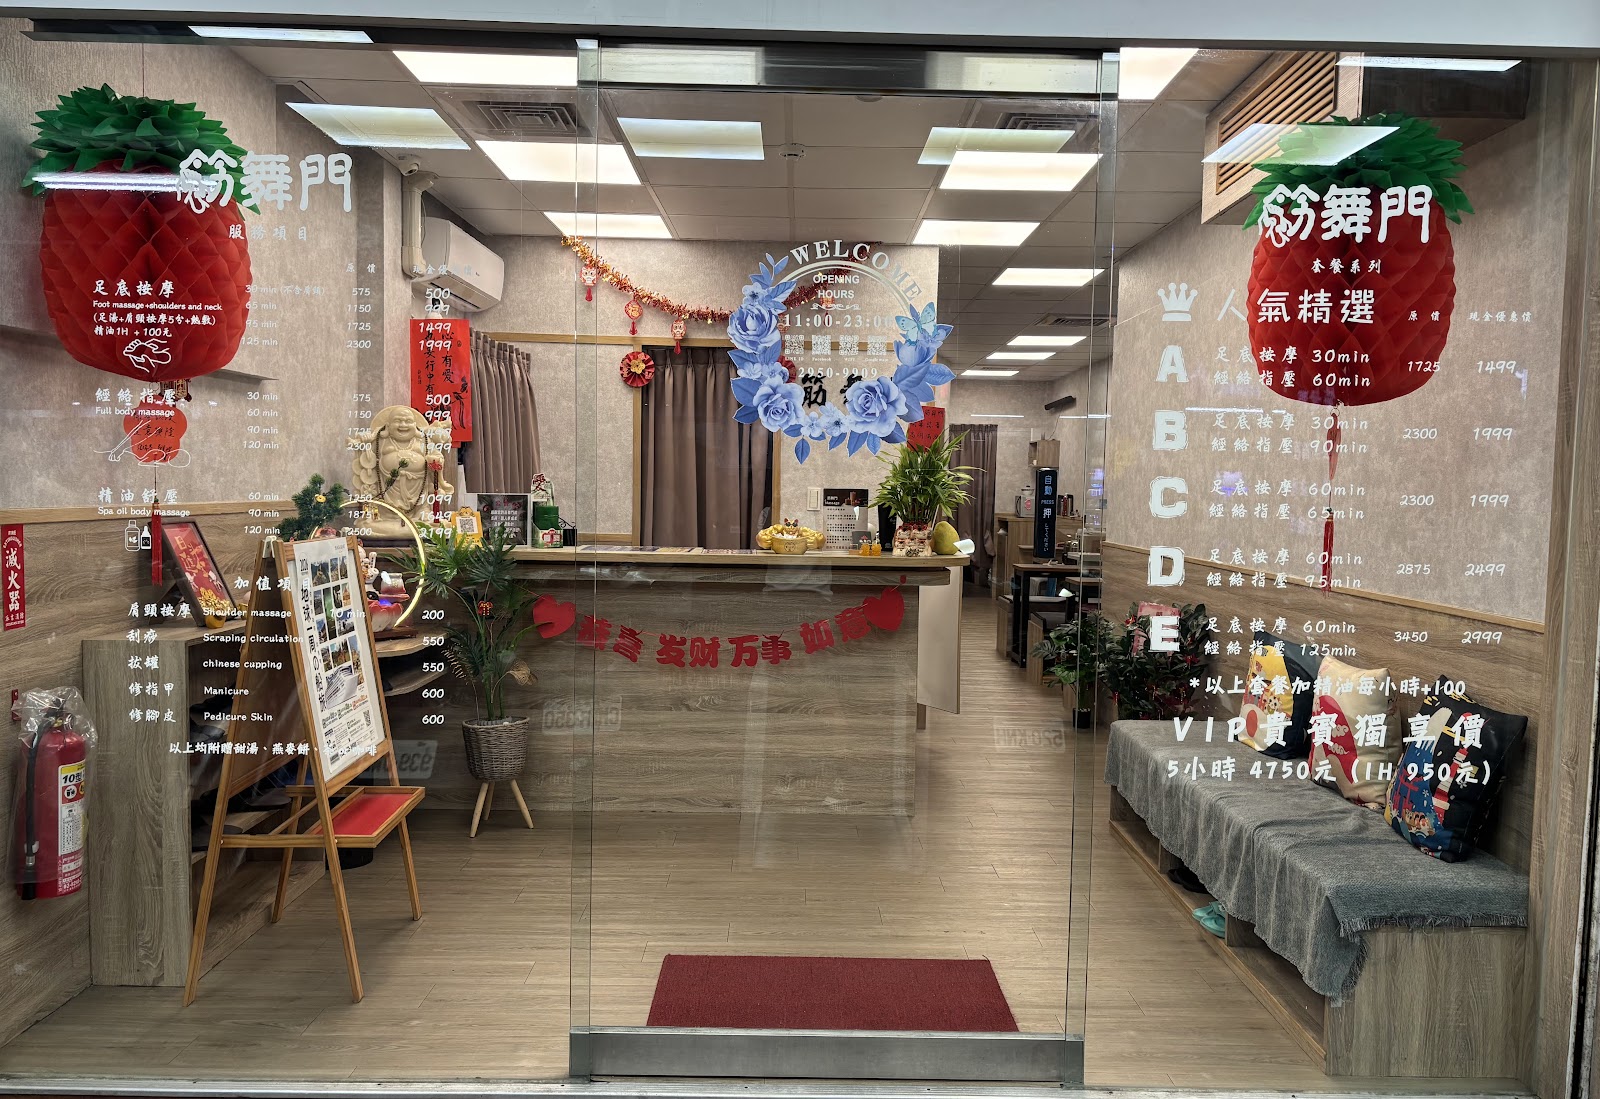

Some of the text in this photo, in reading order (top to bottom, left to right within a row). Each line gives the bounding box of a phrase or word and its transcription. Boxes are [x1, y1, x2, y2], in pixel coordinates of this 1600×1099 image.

[228, 224, 306, 240] 服務項目
[790, 239, 922, 301] WELCOME
[1311, 259, 1382, 274] 套餐系列
[813, 274, 860, 284] OPENING
[93, 280, 174, 298] 足底按摩
[245, 284, 258, 294] 30
[260, 285, 277, 294] min
[352, 288, 370, 296] 575
[425, 288, 450, 299] 500
[818, 289, 854, 299] HOURS
[93, 300, 110, 308] Foot
[246, 301, 277, 310] 65 min
[347, 304, 372, 313] 1150
[425, 304, 450, 316] 999
[1218, 288, 1374, 324] 人氣精選
[1408, 310, 1441, 322] 原價
[1469, 311, 1532, 322] 現金優惠價
[246, 320, 258, 328] 95
[347, 322, 372, 331] 1725
[419, 322, 452, 334] 1499
[94, 326, 172, 337] 精油1H 100元
[242, 337, 278, 346] 125 min
[346, 340, 372, 349] 2300
[420, 340, 452, 352] 1999
[1214, 345, 1370, 365] 足底按摩 30min
[1156, 345, 1189, 384] A
[1407, 360, 1441, 372] 1725
[1477, 360, 1517, 374] 1499
[798, 367, 878, 378] 2950-9909
[1213, 369, 1371, 389] 經絡指壓 60min
[95, 387, 176, 407] 經絡指壓
[247, 391, 278, 400] 30 min
[353, 394, 371, 402] 575
[426, 394, 450, 406] 500
[115, 408, 136, 416] body
[138, 409, 176, 418] massage
[247, 409, 278, 417] 60 min
[348, 411, 372, 420] 1150
[425, 410, 450, 422] 999
[1212, 411, 1368, 431] 足底按摩 30min
[247, 426, 278, 434] 90 min
[348, 427, 372, 436] 1725
[420, 427, 452, 438] 1499
[1152, 411, 1188, 452] B
[1402, 428, 1438, 439] 2300
[1473, 427, 1512, 442] 1999
[243, 440, 279, 449] 120 min
[347, 442, 372, 451] 2300
[420, 442, 452, 453] 1999
[1211, 437, 1368, 454] 經絡指壓 90min
[1044, 475, 1052, 496] 自動
[1210, 478, 1366, 498] 足底按摩 60min
[98, 487, 178, 504] 精油舒壓
[248, 492, 280, 500] 60 min
[348, 494, 372, 502] 1250
[420, 493, 452, 506] 1099
[1149, 476, 1188, 518] C
[1399, 494, 1434, 506] 2300
[1470, 493, 1509, 508] 1999
[98, 507, 190, 517] Spa oil body massage
[248, 509, 280, 518] 90 min
[348, 510, 372, 519] 1875
[1043, 508, 1052, 519] 押
[1208, 502, 1365, 520] 經絡指壓 65min
[244, 526, 262, 534] 120
[347, 528, 372, 536] 2500
[420, 527, 452, 540] 2199
[1208, 548, 1363, 566] 足底按摩 60min
[1147, 545, 1186, 587] D
[1396, 564, 1431, 575] 2875
[1464, 562, 1506, 577] 2499
[6, 548, 21, 612] 滅火器
[1206, 572, 1362, 589] 經絡指壓 95min
[127, 601, 192, 618] 肩頸按摩
[203, 608, 247, 618] Shoulder
[251, 609, 292, 618] massage
[422, 610, 444, 622] 200
[1205, 616, 1356, 634] 足底按摩 60min
[126, 628, 158, 644] 刮痧
[203, 634, 304, 644] Scraping circulation
[1149, 615, 1181, 653] E
[1394, 631, 1428, 643] 3450
[1462, 630, 1502, 645] 2999
[422, 636, 444, 648] 550
[1204, 640, 1356, 657] 經絡指壓 125min
[127, 655, 160, 671] 拔罐
[203, 659, 282, 670] chinese cupping
[422, 662, 444, 674] 550
[128, 682, 174, 697] 修指甲
[204, 686, 250, 696] Manicure
[422, 688, 444, 700] 600
[128, 708, 177, 724] 修腳皮
[204, 712, 273, 722] Pedicure Skin
[422, 714, 444, 726] 600
[1167, 756, 1236, 781] 5小時
[1250, 758, 1337, 781] 4750元
[1407, 758, 1492, 785] 950元)
